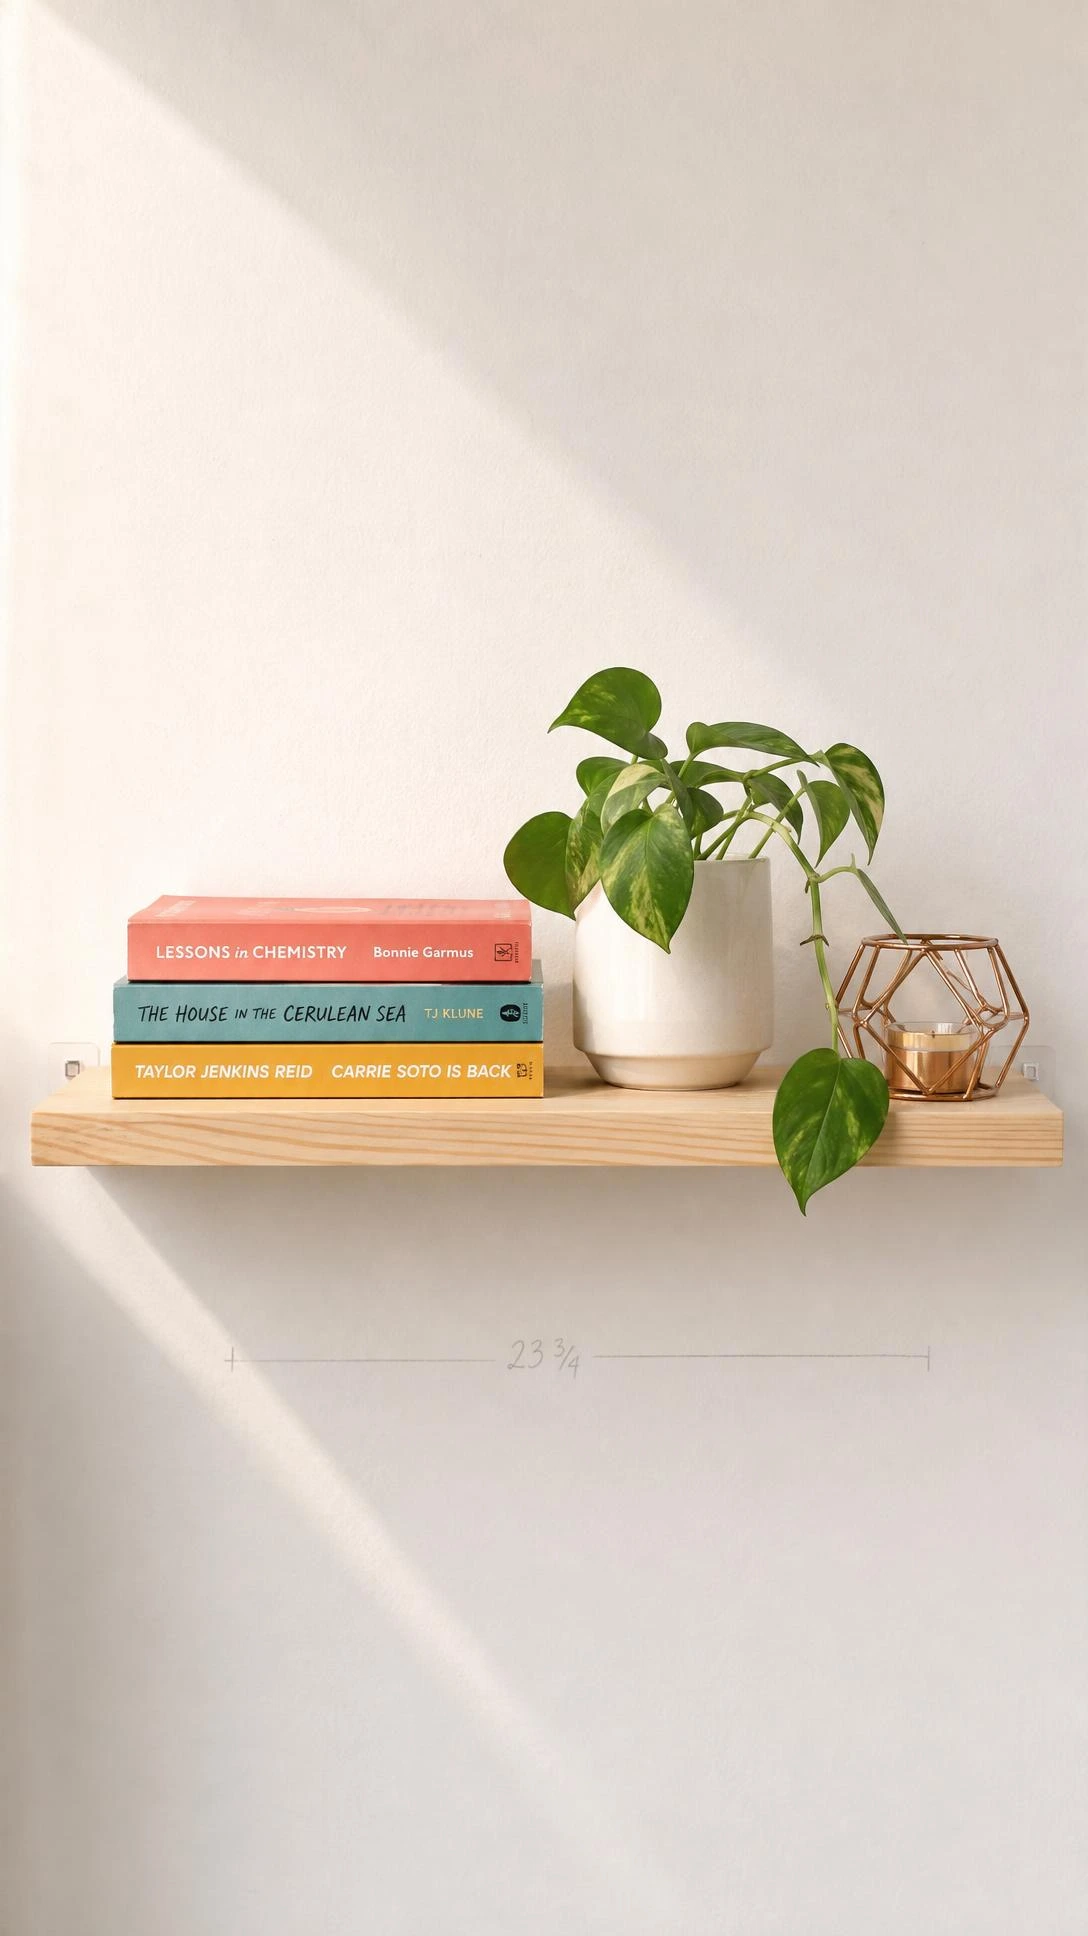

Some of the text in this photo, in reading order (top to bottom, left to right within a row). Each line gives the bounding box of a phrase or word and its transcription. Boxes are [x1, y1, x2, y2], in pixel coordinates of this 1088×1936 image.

[156, 945, 347, 959] LESSONS in CHEMISTRY
[373, 946, 474, 958] Bonnie Garmus
[137, 1004, 406, 1023] THE HOUSE IN THE CERULEAN SEA
[424, 1008, 483, 1019] TJ KLUNE
[135, 1064, 313, 1079] TAYLOR JENKINS REID
[331, 1064, 391, 1079] CARRIE
[396, 1064, 442, 1079] SOTO
[446, 1064, 462, 1078] IS
[466, 1064, 512, 1078] BACK
[506, 1339, 544, 1370] 23
